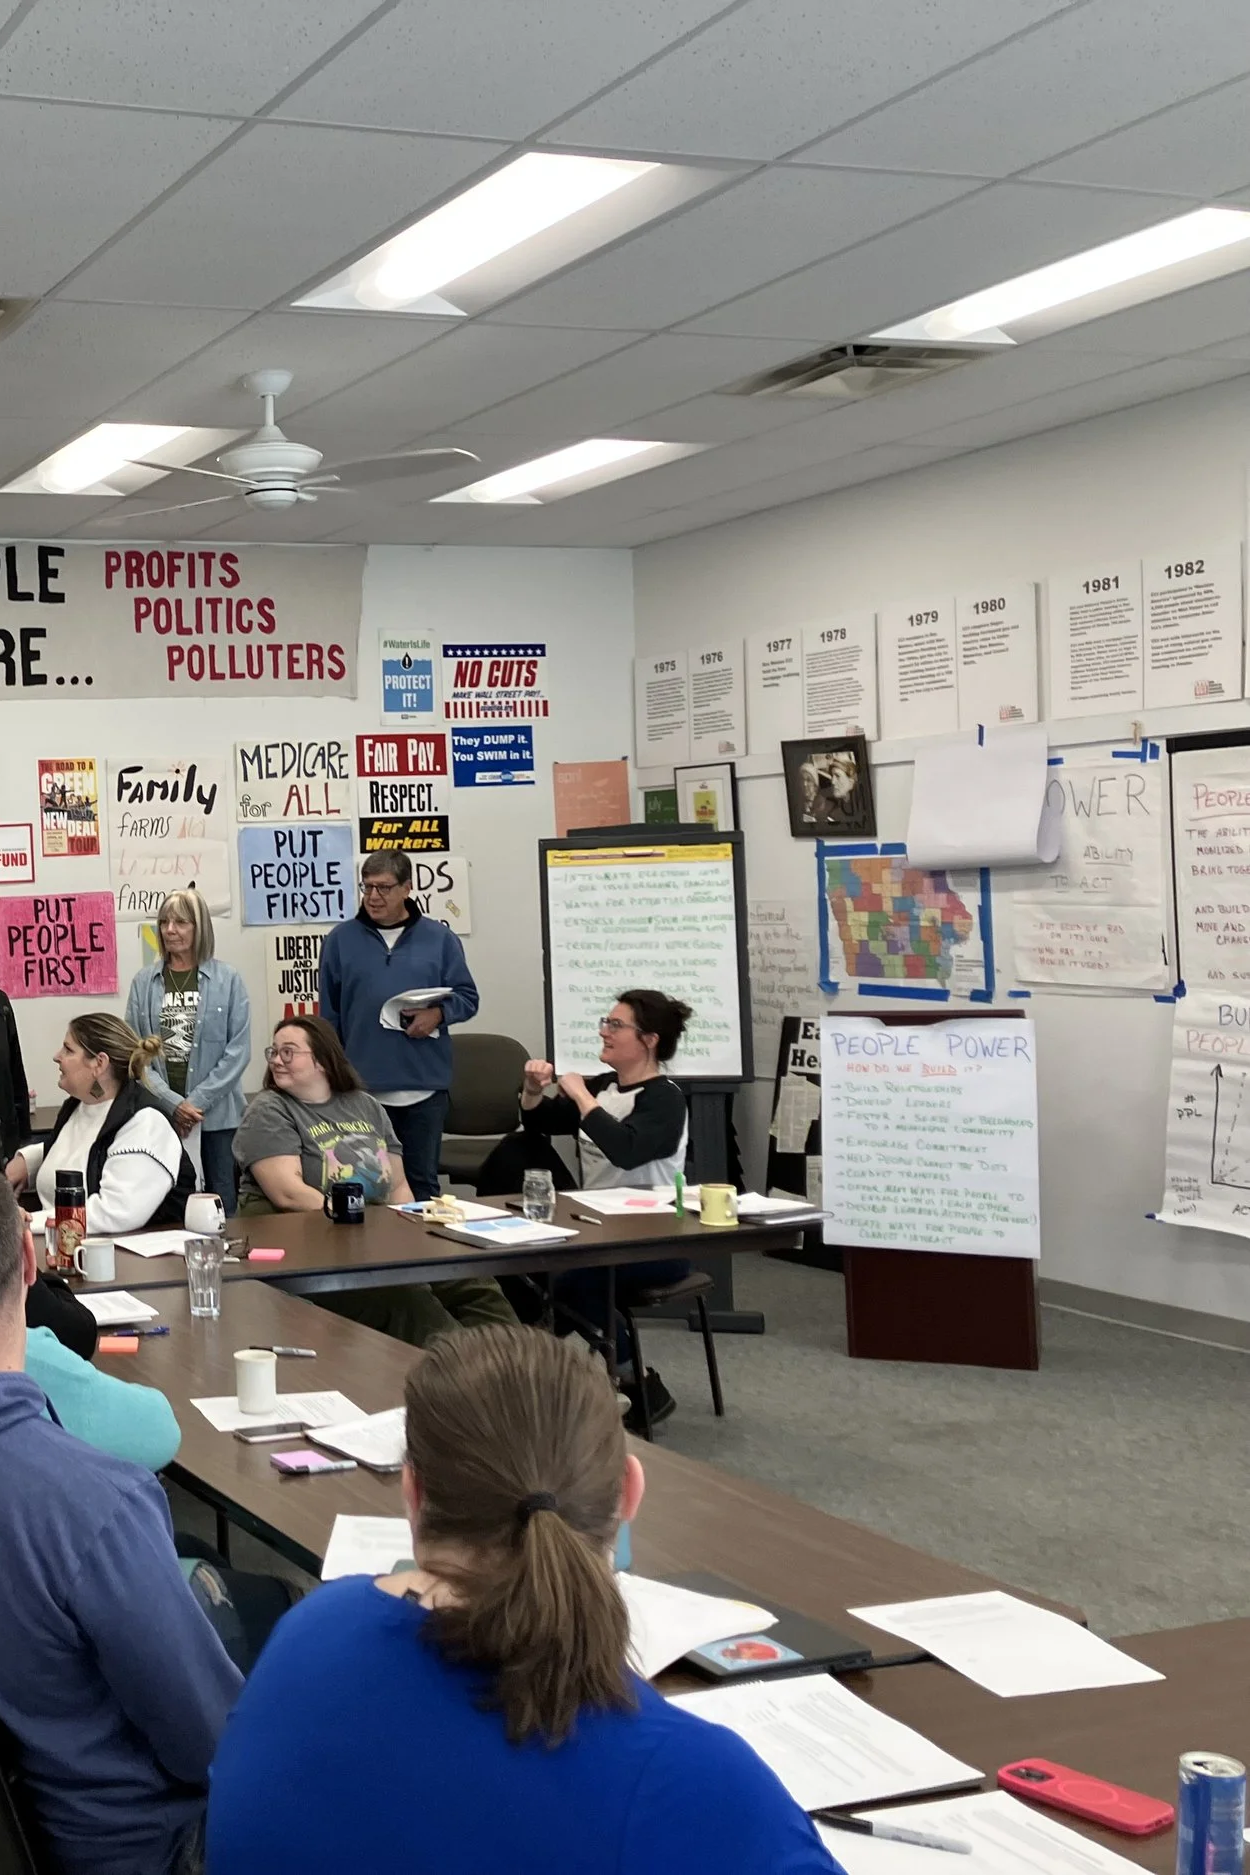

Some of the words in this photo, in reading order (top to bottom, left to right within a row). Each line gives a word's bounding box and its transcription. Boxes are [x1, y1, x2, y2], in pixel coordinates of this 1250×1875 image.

[104, 550, 241, 589] PROFITS
[1164, 559, 1205, 580] 1982
[1082, 575, 1119, 594] 1981
[973, 597, 1006, 615] 1980
[134, 597, 276, 635] POLITICS
[908, 610, 939, 627] 1979
[383, 639, 431, 649] #WaterIsLife
[820, 628, 847, 643] 1978
[766, 638, 792, 653] 1977
[167, 643, 347, 681] POLLUTERS
[654, 660, 676, 674] 1975
[700, 652, 723, 665] 1976
[384, 675, 431, 690] PROTECT
[453, 660, 483, 688] NO
[487, 660, 538, 688] CUTS
[402, 693, 417, 708] IT!
[452, 691, 473, 699] MAKE
[475, 691, 493, 699] WALL
[495, 690, 523, 698] STREET
[452, 736, 480, 747] They
[483, 734, 515, 745] DUMP
[517, 734, 528, 744] it.
[240, 741, 349, 782] MEDICARE
[363, 738, 399, 774] FAIR
[407, 738, 441, 772] PAY.
[453, 751, 474, 761] You
[476, 750, 507, 761] SWIM
[510, 750, 520, 759] in
[522, 750, 533, 759] it.
[55, 762, 75, 771] ROAD
[77, 762, 86, 770] TO
[89, 761, 94, 770] A
[41, 772, 95, 795] GREEN
[240, 794, 273, 818] for
[283, 782, 341, 816] ALL
[369, 780, 438, 814] RESPECT.
[1047, 773, 1150, 818] OWER
[43, 811, 68, 829] NEW
[67, 820, 97, 837] DEAL
[372, 821, 403, 834] For
[408, 820, 439, 833] ALL
[1185, 829, 1208, 838] THE
[1216, 828, 1250, 838] ABILIT
[70, 837, 97, 852] TOUR
[274, 829, 323, 858] PUT
[365, 836, 445, 851] Workers.
[1083, 846, 1133, 860] ABILITY
[250, 861, 342, 889] PEOPLE
[1079, 876, 1113, 889] ACT
[33, 897, 76, 923] PUT
[266, 889, 345, 919] FIRST!
[1195, 905, 1214, 915] AND
[7, 922, 105, 957] PEOPLE
[24, 956, 91, 987] FIRST
[293, 960, 312, 969] AND
[278, 968, 319, 994] JUSTIC
[293, 993, 314, 1002] FOR
[830, 1032, 920, 1056] PEOPLE
[946, 1034, 1031, 1062] POWER
[1186, 1029, 1250, 1055] PEOPL
[846, 1063, 870, 1073] HOW
[874, 1064, 889, 1073] DO
[897, 1064, 912, 1073] WE
